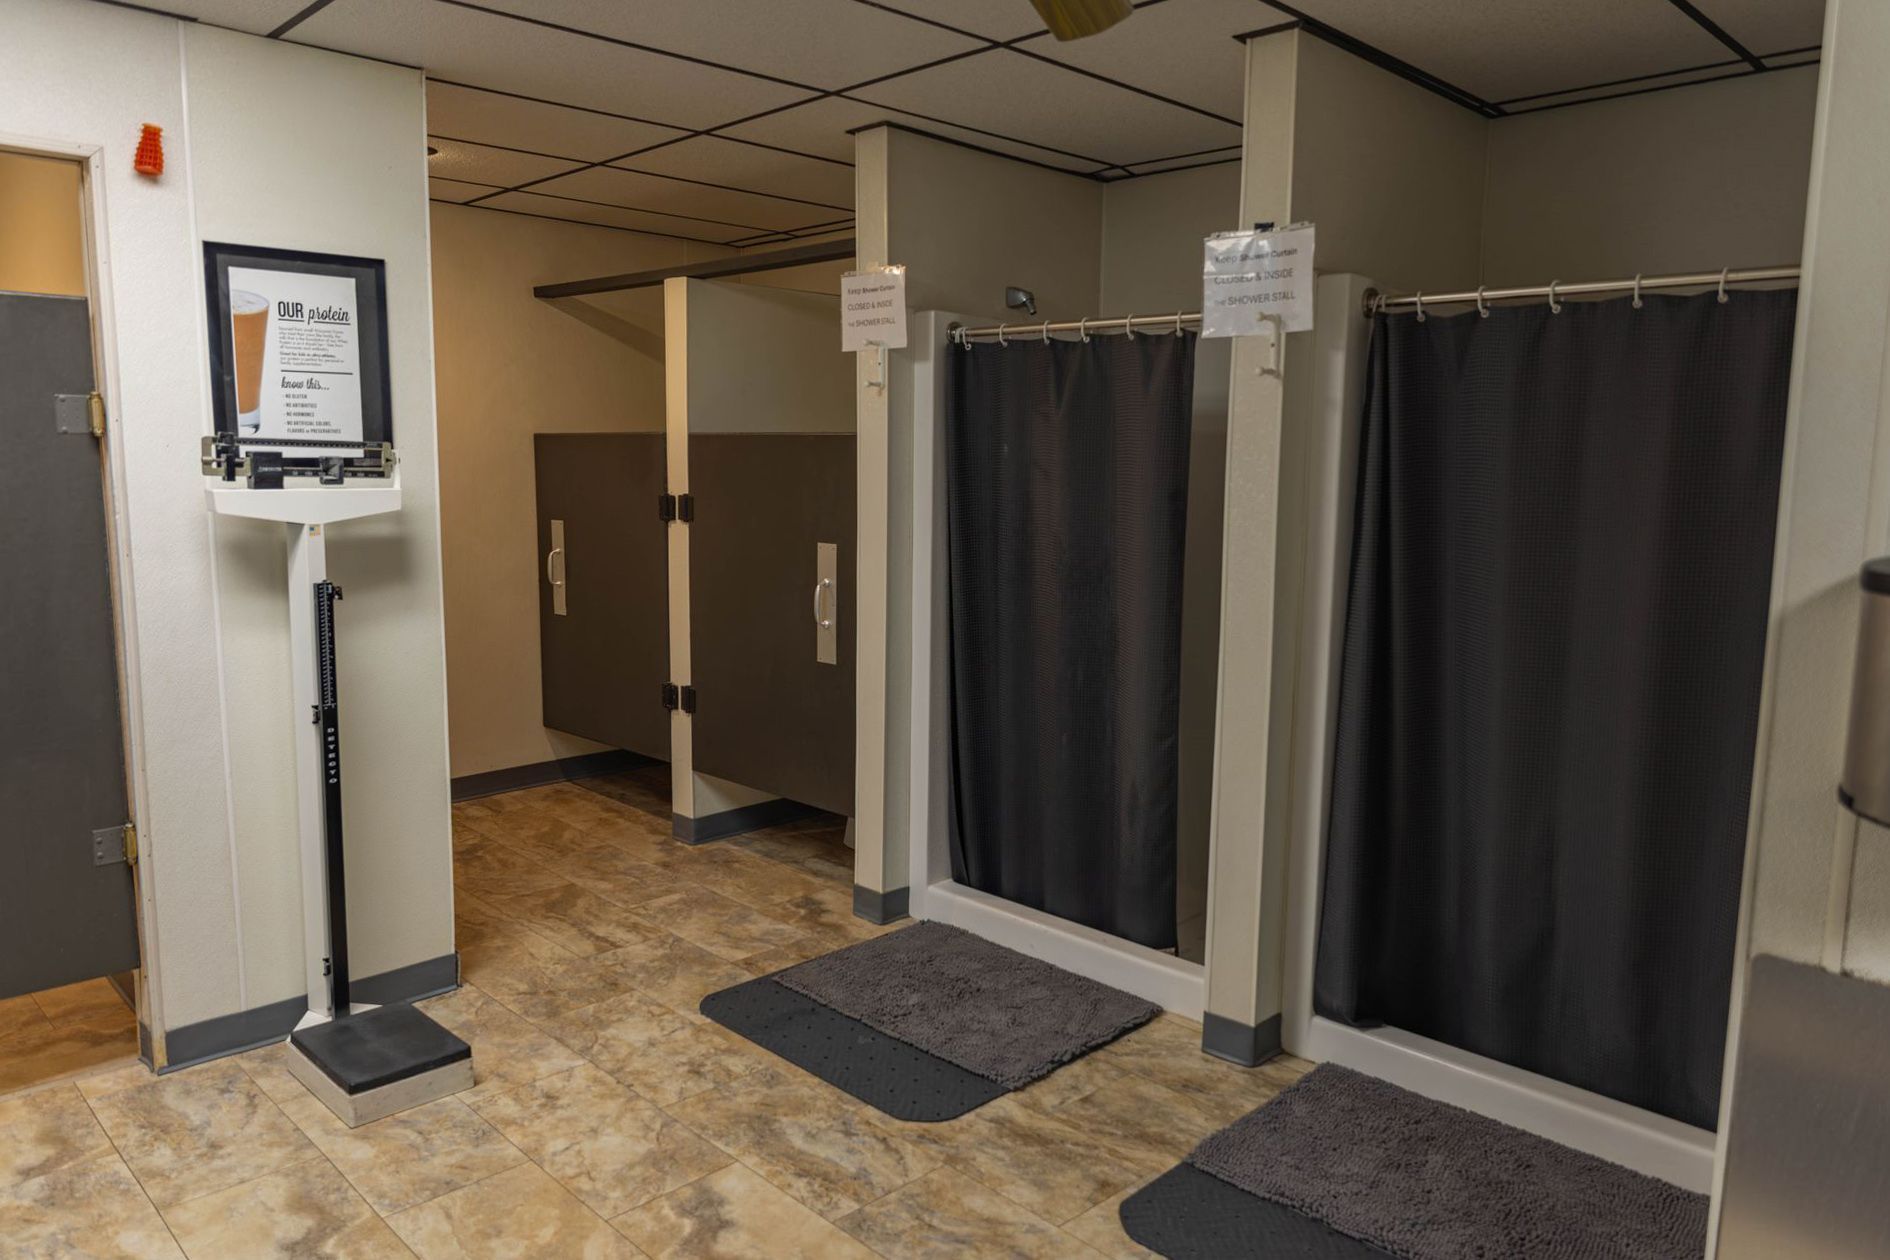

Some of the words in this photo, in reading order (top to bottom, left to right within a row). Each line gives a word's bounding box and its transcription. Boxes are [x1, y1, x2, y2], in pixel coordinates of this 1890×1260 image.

[1215, 256, 1237, 264] Keep
[1240, 252, 1268, 262] Shower
[1271, 248, 1298, 258] Curtain
[1214, 274, 1254, 285] CLOSED
[1256, 272, 1262, 281] &
[1264, 268, 1294, 280] INSIDE
[848, 302, 870, 311] CLOSED
[877, 300, 893, 308] INSIDE
[1228, 294, 1270, 306] SHOWER
[1271, 291, 1295, 302] STALL
[278, 301, 304, 318] OUR
[307, 305, 349, 325] protein
[856, 319, 880, 327] SHOWER
[281, 376, 304, 388] know
[307, 377, 330, 390] this...
[327, 727, 338, 784] DETECTO
